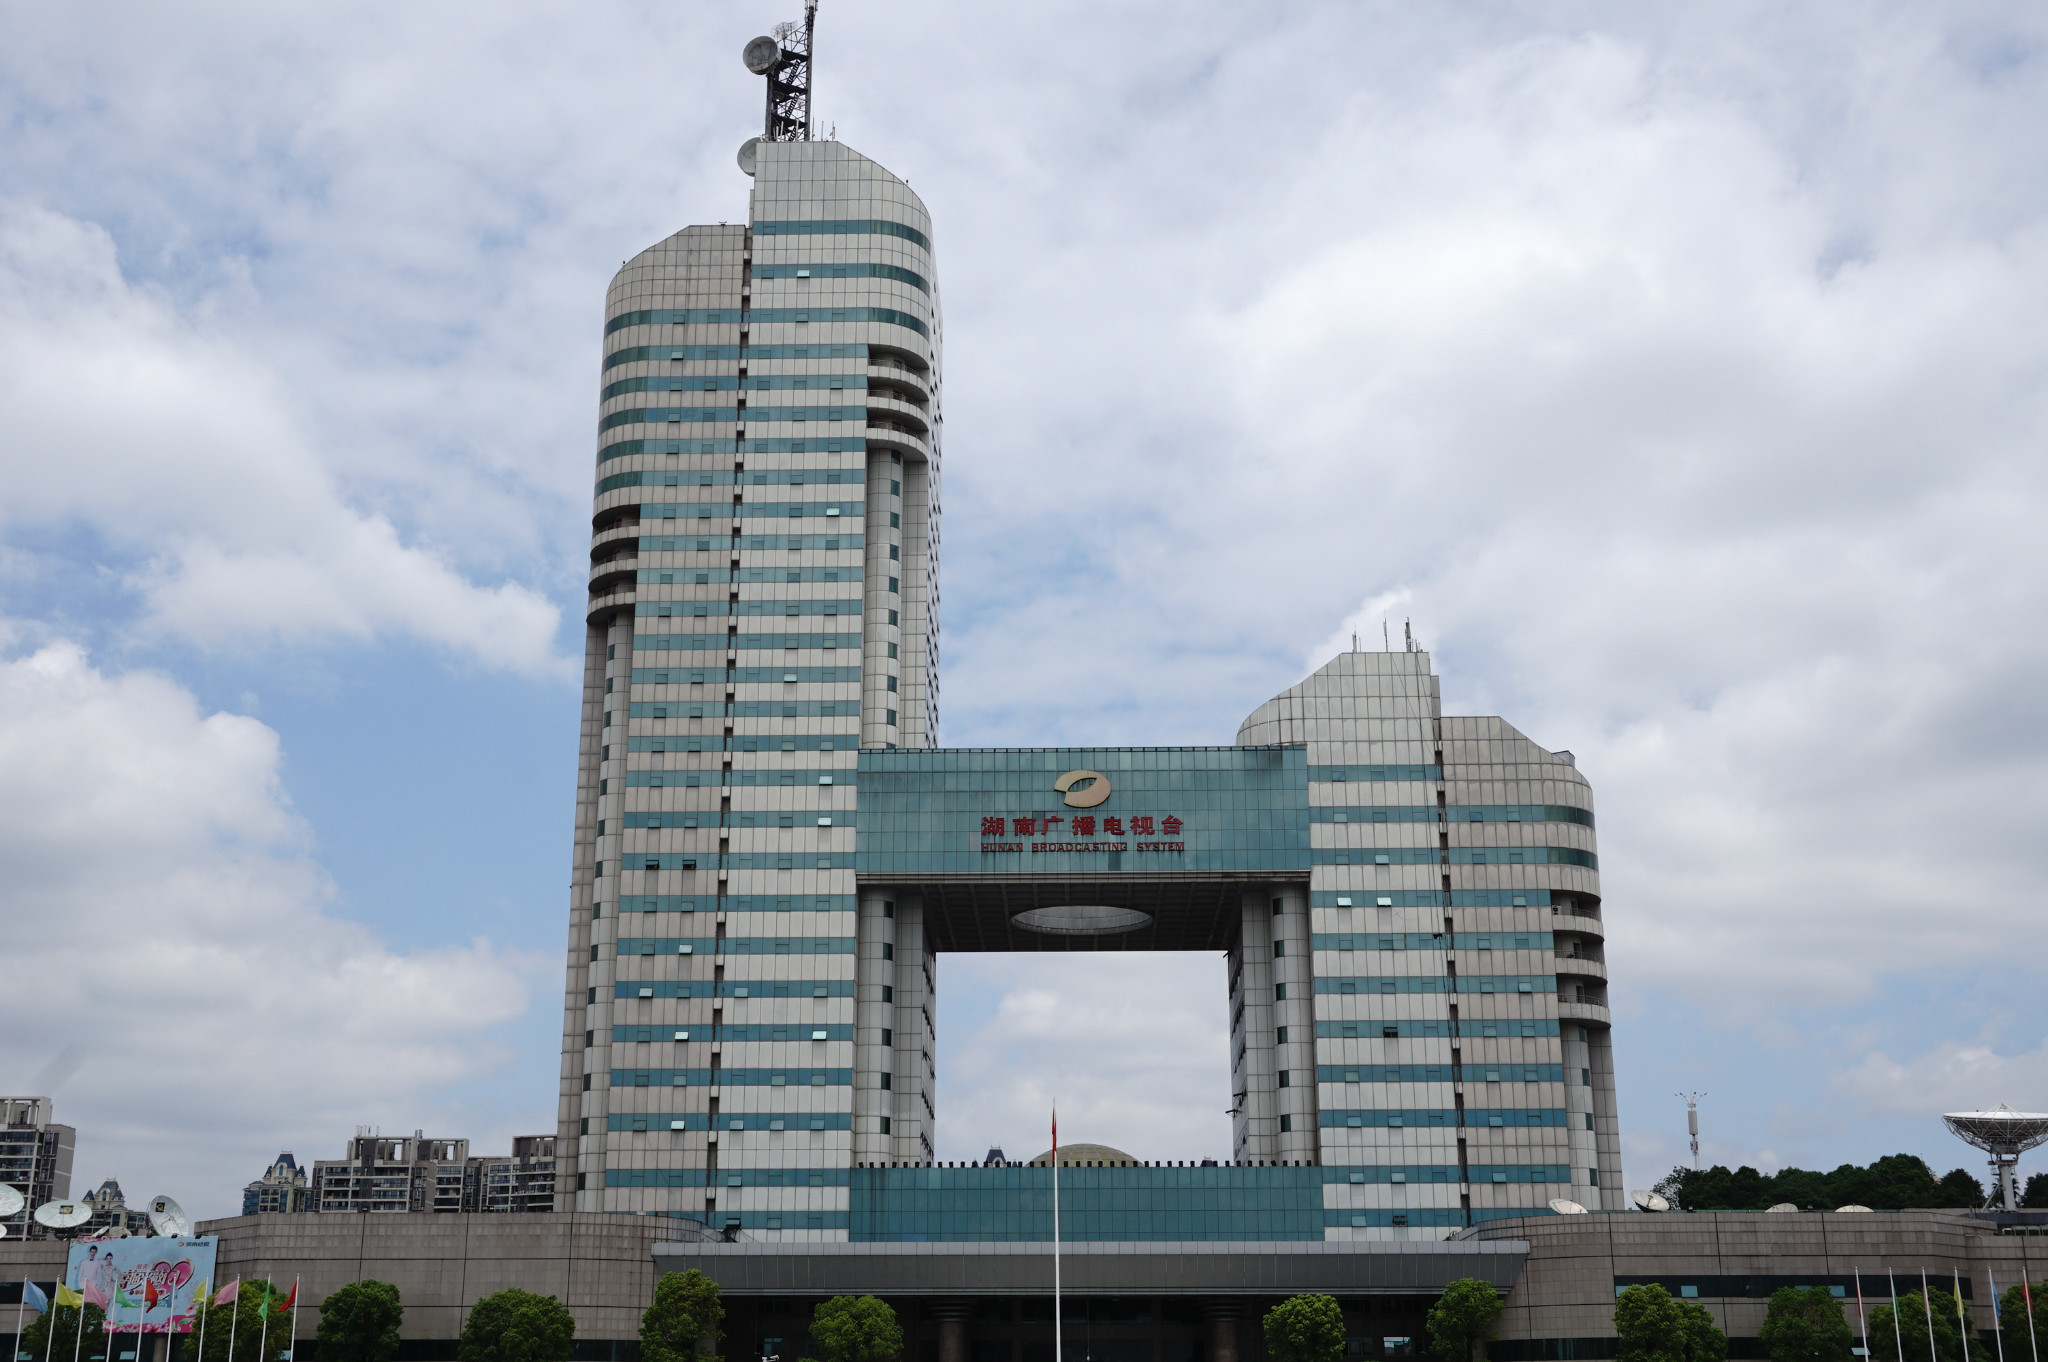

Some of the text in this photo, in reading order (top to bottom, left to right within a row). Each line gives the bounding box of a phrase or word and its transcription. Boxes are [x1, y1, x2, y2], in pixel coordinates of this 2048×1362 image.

[981, 816, 1184, 836] 湖南广播电视台
[981, 841, 1185, 852] HUNAN BROADCASTING SYSTEM
